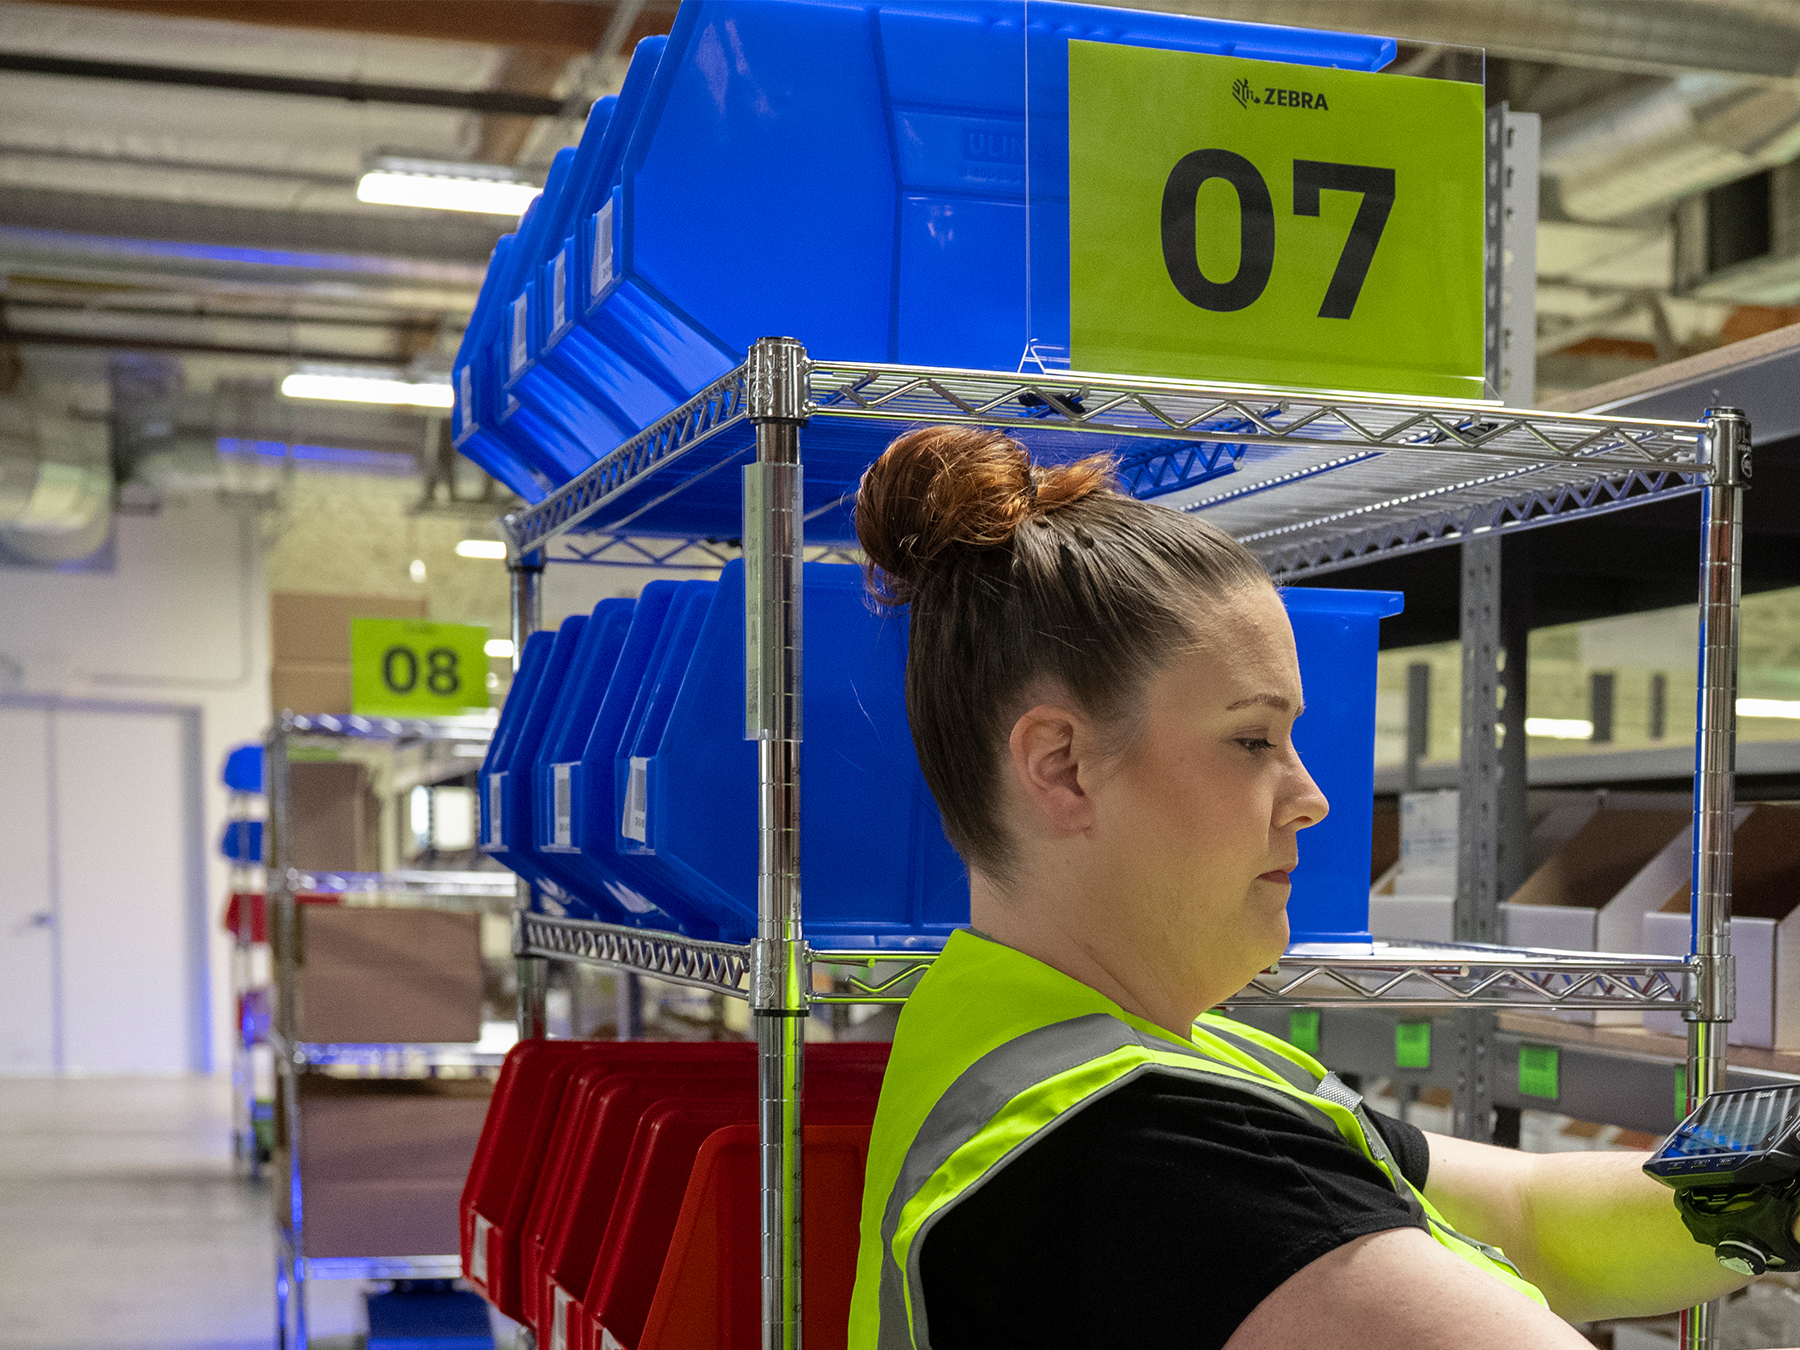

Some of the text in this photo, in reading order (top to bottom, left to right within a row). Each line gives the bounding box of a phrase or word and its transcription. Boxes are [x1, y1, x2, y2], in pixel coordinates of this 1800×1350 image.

[1263, 87, 1329, 111] ZEBRA
[1160, 148, 1396, 320] 07
[384, 645, 459, 696] 08
